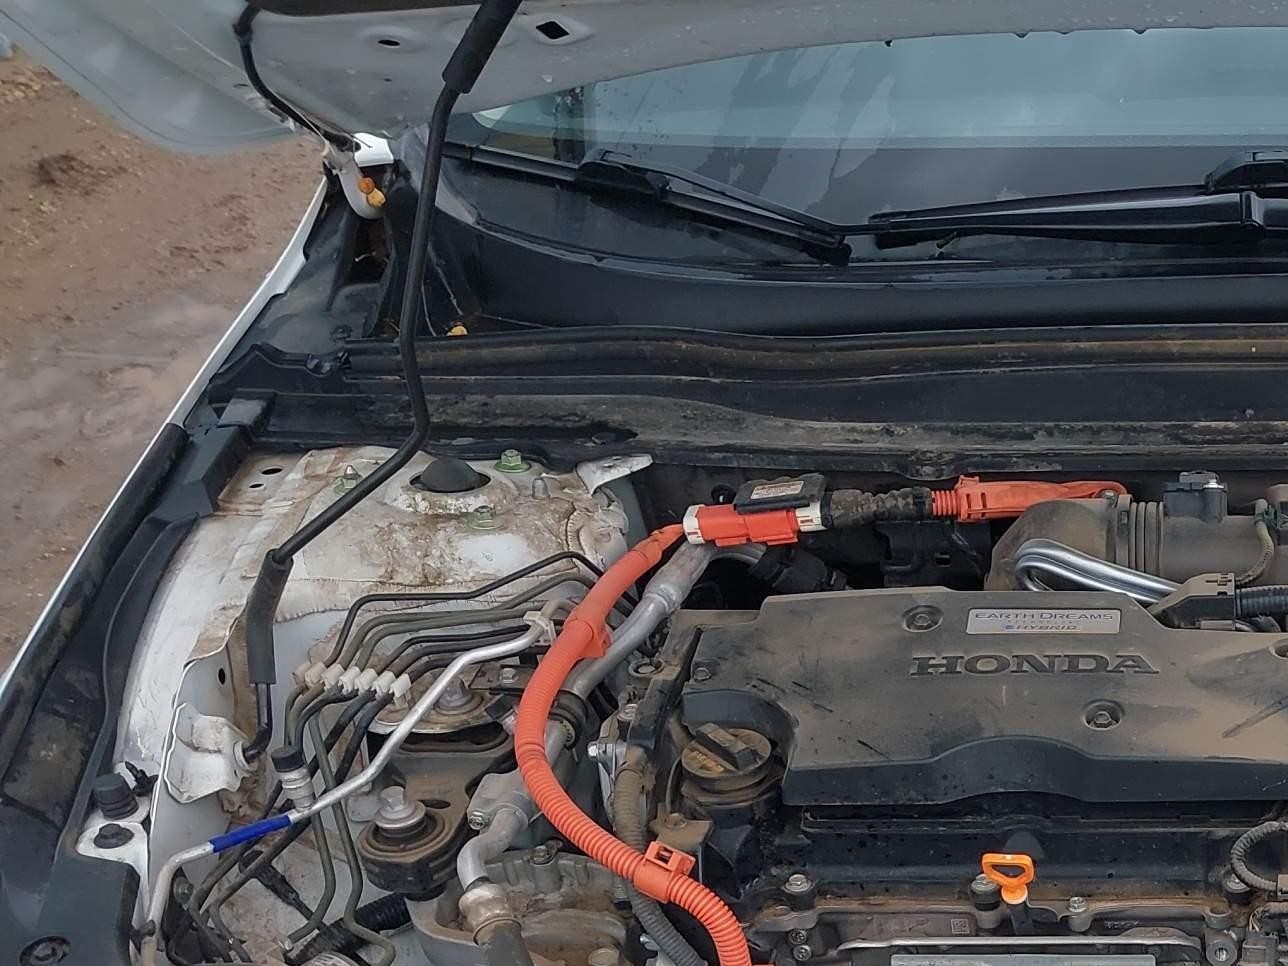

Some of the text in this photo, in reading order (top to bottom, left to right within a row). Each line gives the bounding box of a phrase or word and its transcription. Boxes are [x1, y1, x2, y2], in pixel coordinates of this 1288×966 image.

[975, 612, 1114, 620] EARTH DREAMS
[910, 653, 1160, 676] HONDA
